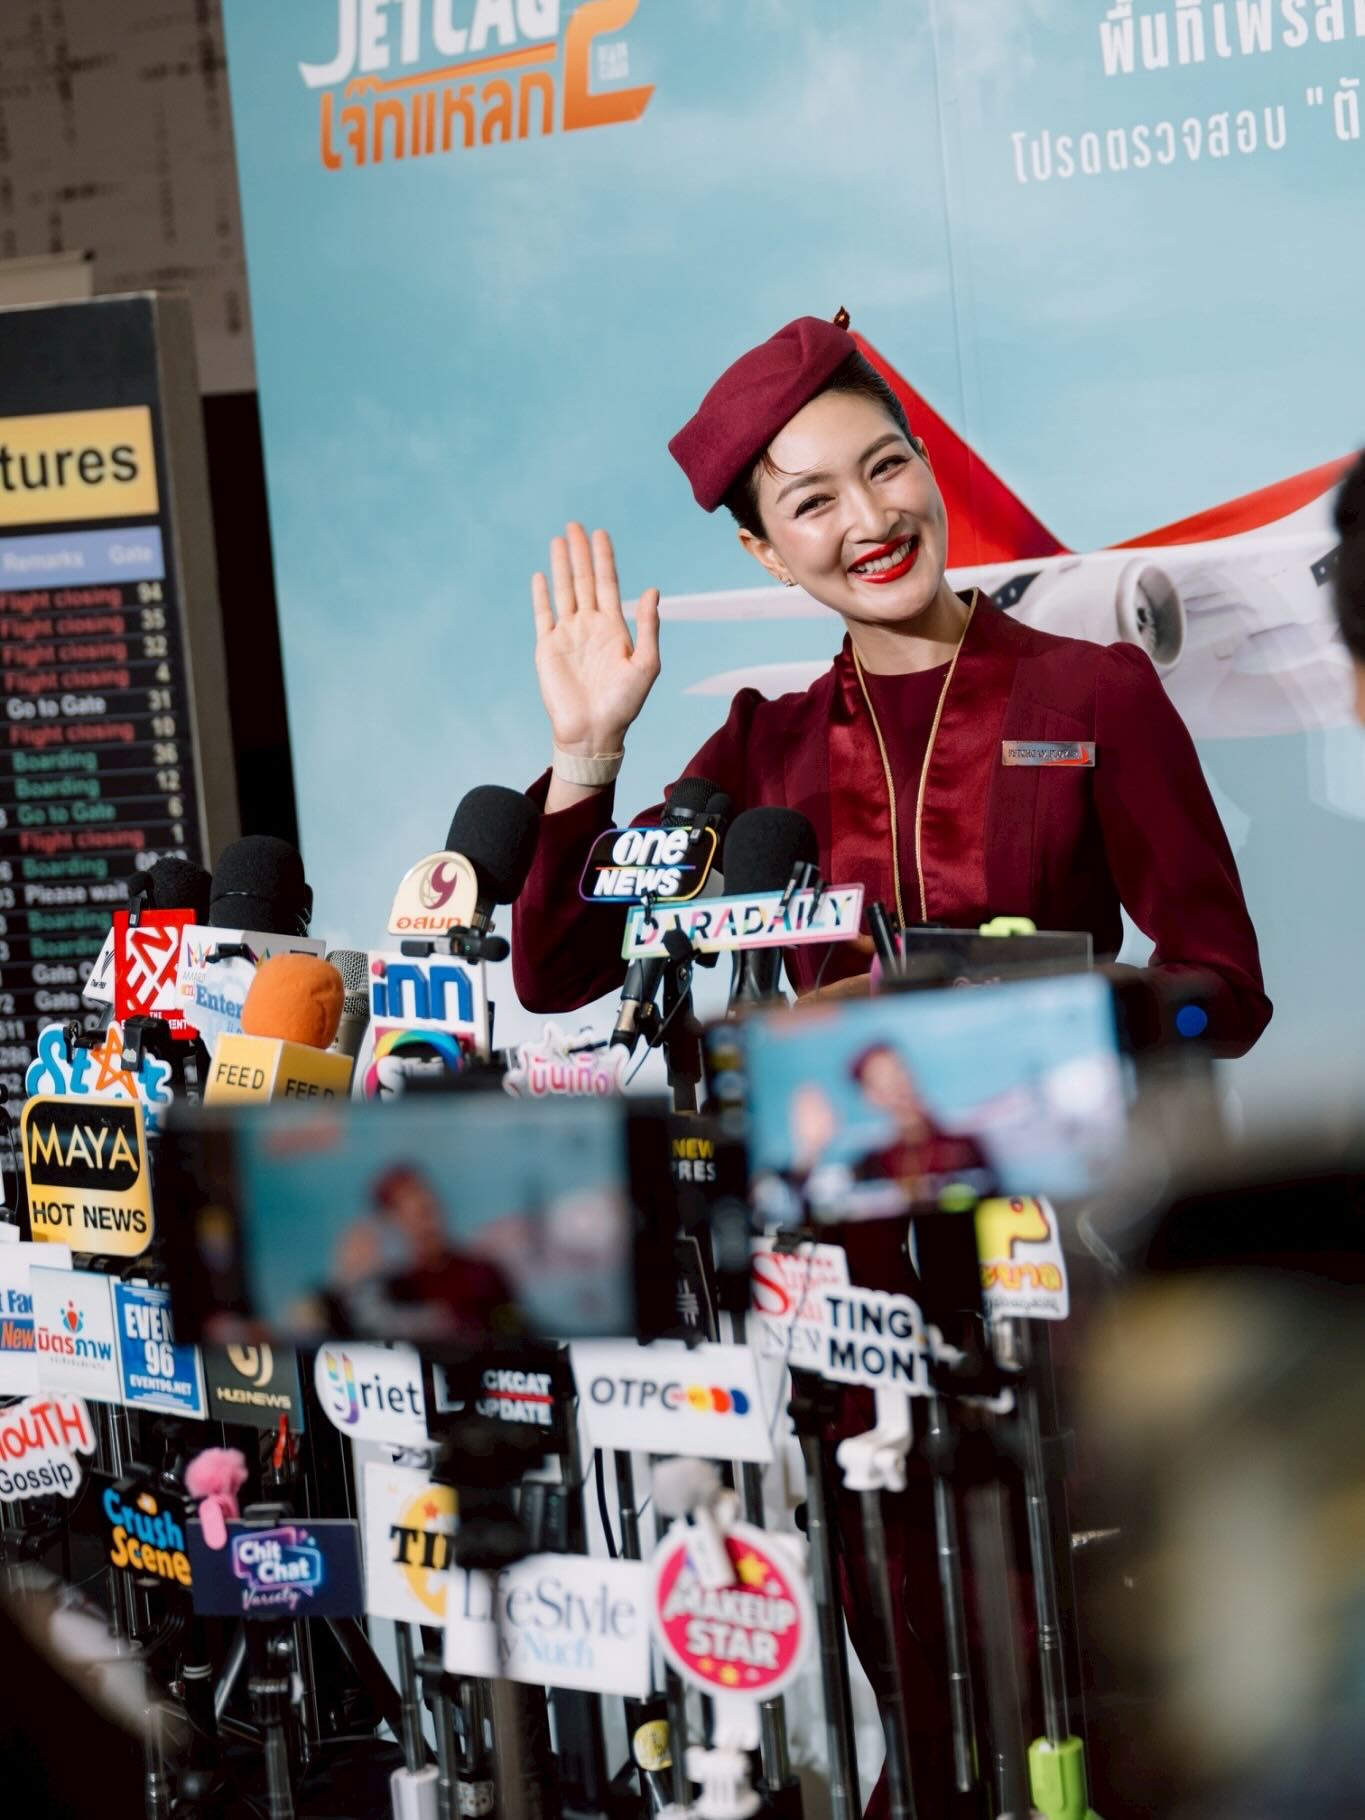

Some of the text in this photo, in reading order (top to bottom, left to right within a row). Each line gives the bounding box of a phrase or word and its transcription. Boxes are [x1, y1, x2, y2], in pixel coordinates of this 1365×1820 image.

[1011, 105, 1287, 183] โปรดตรวจสอบ
[0, 445, 138, 491] tures
[4, 545, 153, 572] Remarks Gate
[54, 587, 122, 609] closing
[0, 618, 52, 642] Flight
[57, 614, 125, 636] closing
[2, 645, 55, 668] Flight
[58, 642, 128, 664] closing
[5, 662, 171, 695] Flight closing 4
[6, 697, 36, 719] Go
[37, 698, 59, 718] to
[61, 694, 106, 716] Gate
[9, 724, 63, 749] Flight
[66, 721, 135, 744] closing
[12, 749, 97, 772] Boarding
[15, 776, 99, 799] Boarding
[17, 803, 46, 825] Go
[48, 804, 69, 824] to
[71, 800, 116, 821] Gate
[20, 830, 73, 855] Flight
[77, 828, 144, 851] closing
[612, 829, 689, 866] one
[22, 858, 108, 881] Boarding
[593, 867, 682, 897] NEWS
[24, 883, 87, 905] Please
[32, 963, 77, 985] Gate
[34, 990, 79, 1012] Gate
[373, 960, 474, 1022] inn
[215, 1063, 265, 1090] FEED
[31, 1121, 138, 1171] MAYA
[32, 1201, 147, 1233] HOT NEWS
[826, 1296, 913, 1338] TING
[38, 1327, 111, 1360] มิตรภาพ
[144, 1340, 174, 1378] 96
[0, 1459, 73, 1494] Gossip
[103, 1488, 184, 1551] Crush
[111, 1526, 192, 1586] Scene
[240, 1541, 281, 1564] Chit
[258, 1560, 309, 1583] Chat
[242, 1587, 300, 1611] Variety
[686, 1619, 778, 1670] STAR
